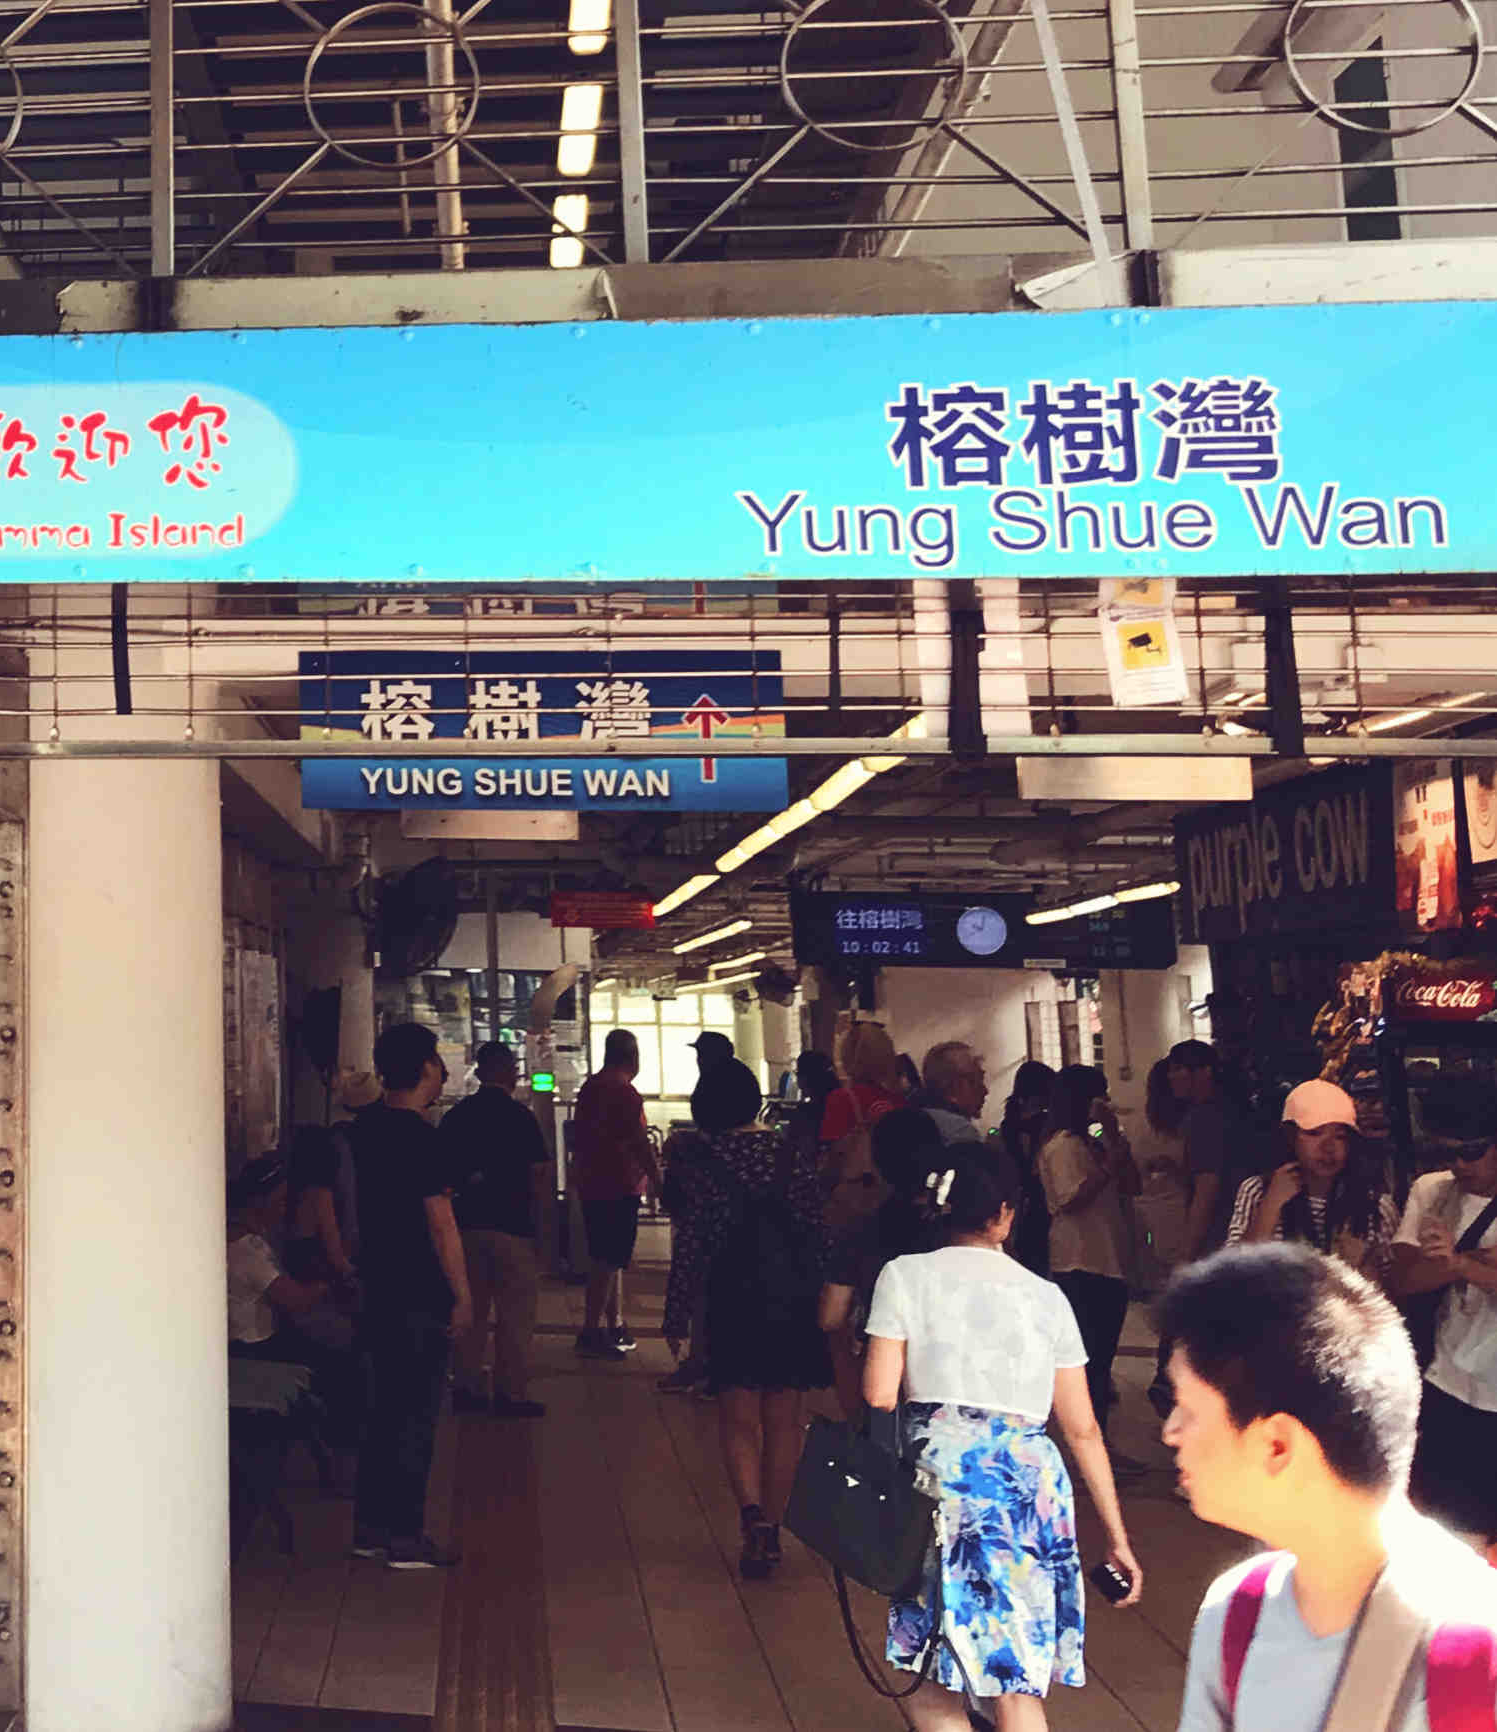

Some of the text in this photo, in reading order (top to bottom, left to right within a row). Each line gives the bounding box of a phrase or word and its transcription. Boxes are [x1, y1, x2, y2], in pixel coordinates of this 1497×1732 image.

[887, 378, 1281, 488] 榕樹灣
[108, 513, 244, 548] Island
[740, 484, 1447, 566] Yung Shue Wan
[360, 679, 653, 740] 榕樹灣
[360, 767, 670, 796] YUNG SHUE WAN
[1190, 806, 1282, 938] purple
[836, 908, 924, 930] 往榕樹灣
[1397, 977, 1484, 1008] Coca-Cola
